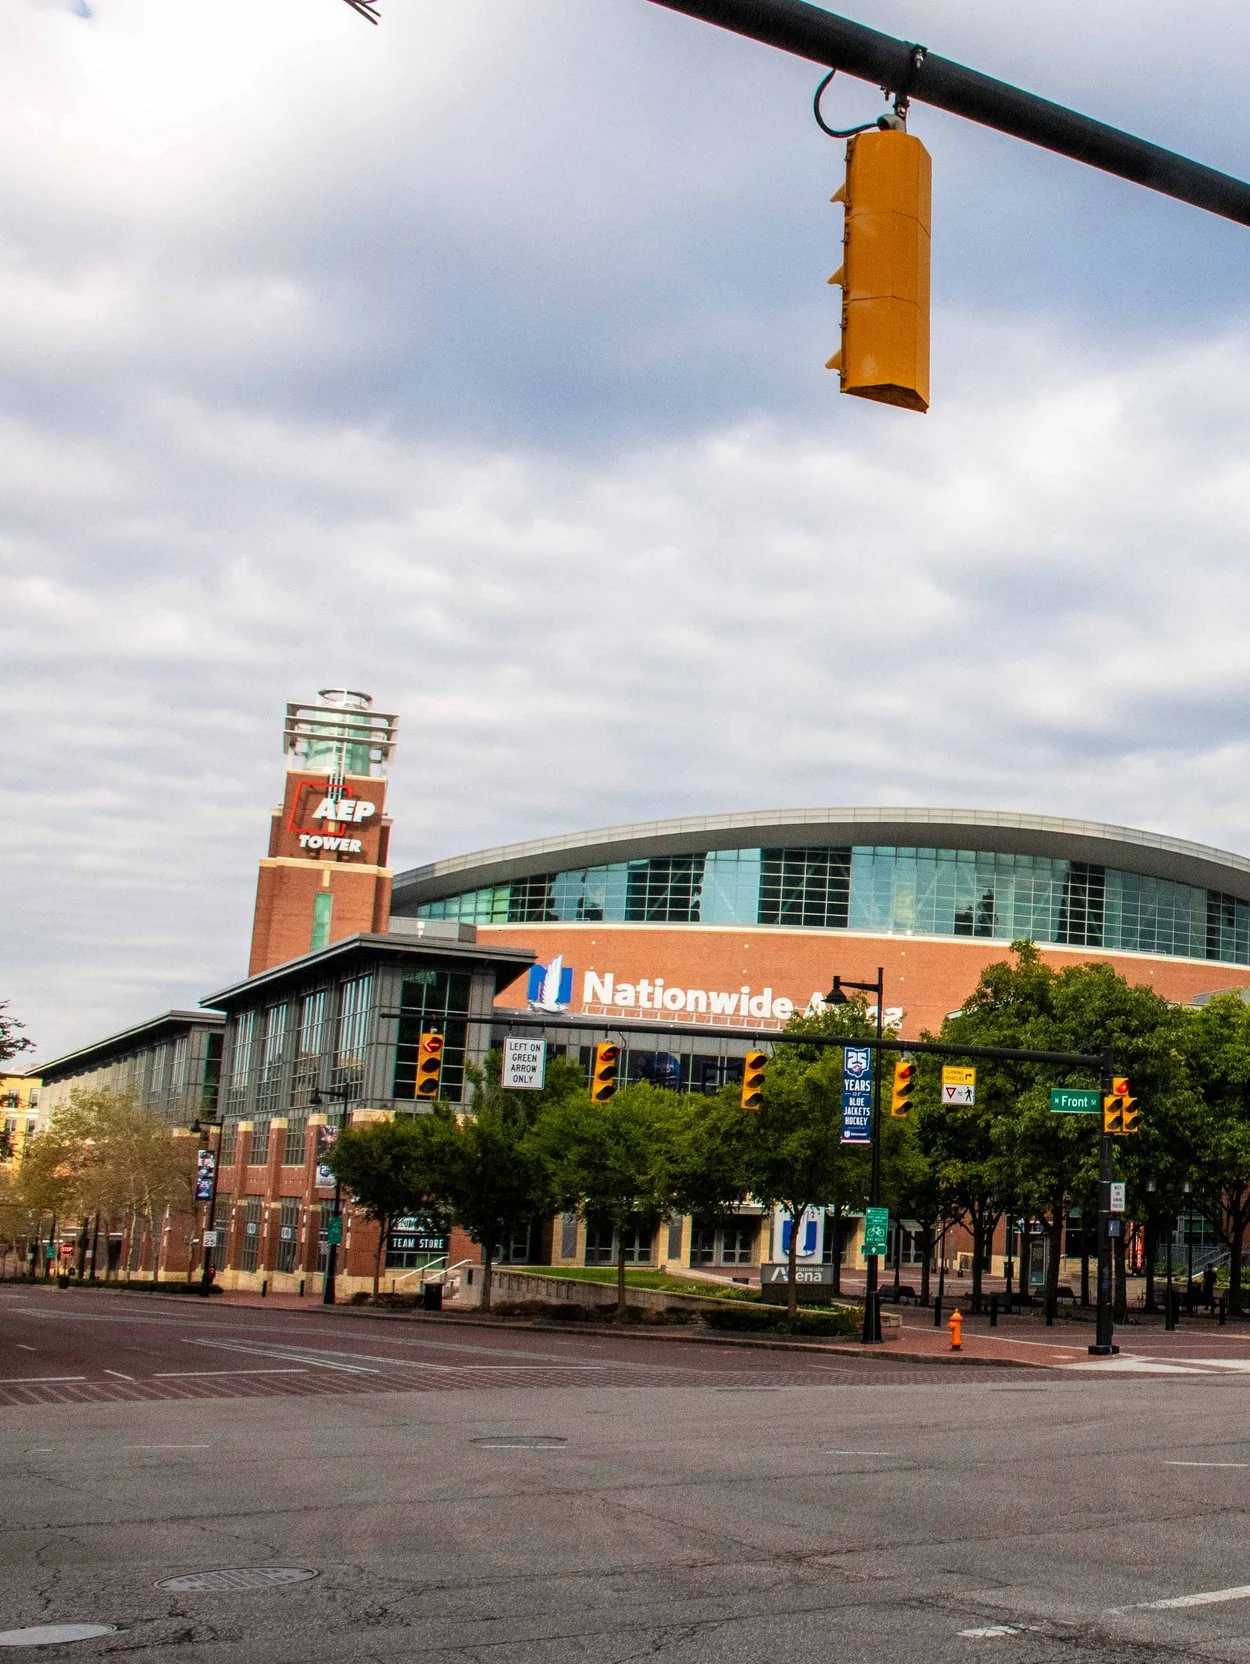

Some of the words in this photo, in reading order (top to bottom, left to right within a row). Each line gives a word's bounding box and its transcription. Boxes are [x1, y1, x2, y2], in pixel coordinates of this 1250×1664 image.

[312, 798, 376, 822] AEP
[299, 834, 362, 853] TOWER
[583, 970, 794, 1020] Nationwide
[510, 1042, 527, 1051] LEFT
[530, 1043, 541, 1052] ON
[512, 1053, 537, 1062] GREEN
[847, 1051, 867, 1069] 25
[511, 1064, 537, 1073] ARROW
[513, 1074, 533, 1083] ONLY
[844, 1079, 871, 1091] YEARS
[849, 1097, 865, 1107] BLUE
[1061, 1095, 1088, 1107] Front
[843, 1107, 871, 1116] JACKETS
[844, 1117, 868, 1126] HOCKEY
[393, 1238, 415, 1248] TEAM
[419, 1239, 444, 1248] STORE
[771, 1266, 822, 1282] Aena
